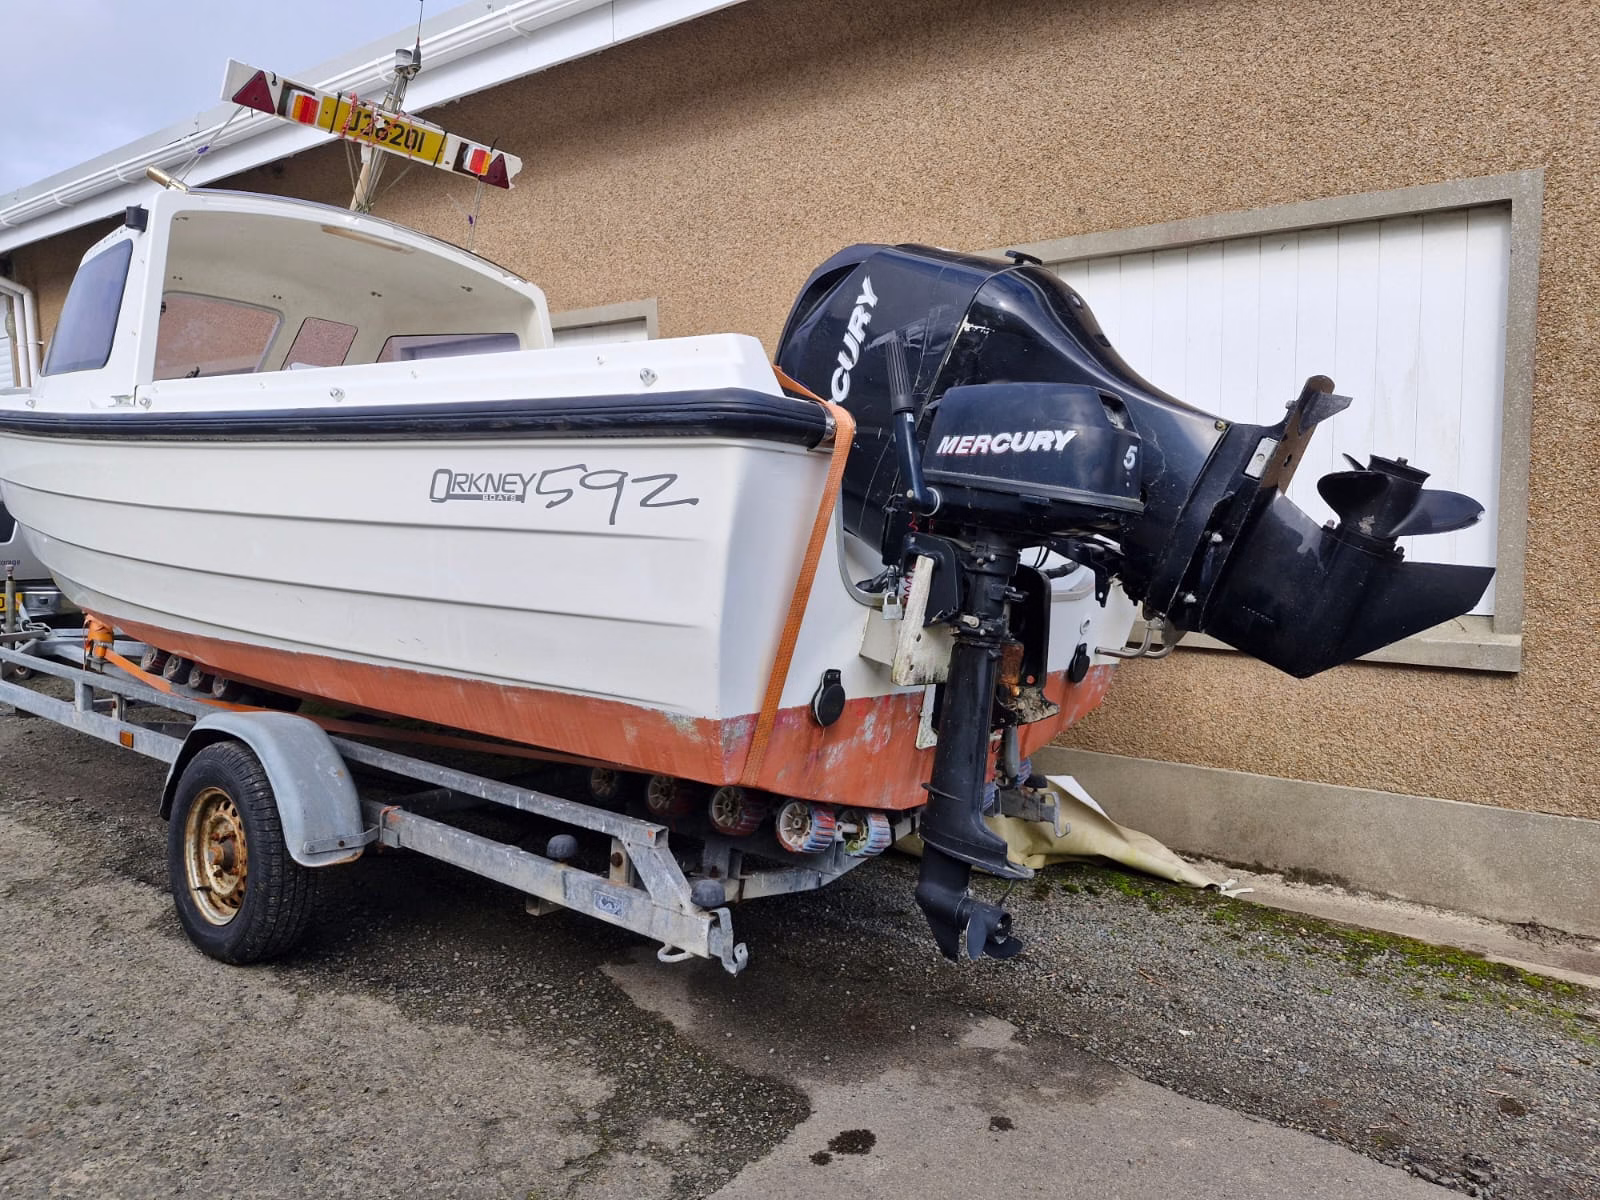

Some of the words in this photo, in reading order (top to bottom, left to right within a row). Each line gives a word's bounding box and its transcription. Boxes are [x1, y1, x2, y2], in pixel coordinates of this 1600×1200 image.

[829, 275, 879, 403] CURY
[936, 430, 1078, 456] MERCURY
[1123, 445, 1138, 470] 5
[429, 468, 537, 503] ORKNEY
[536, 463, 699, 525] 592
[482, 494, 516, 502] BOATS
